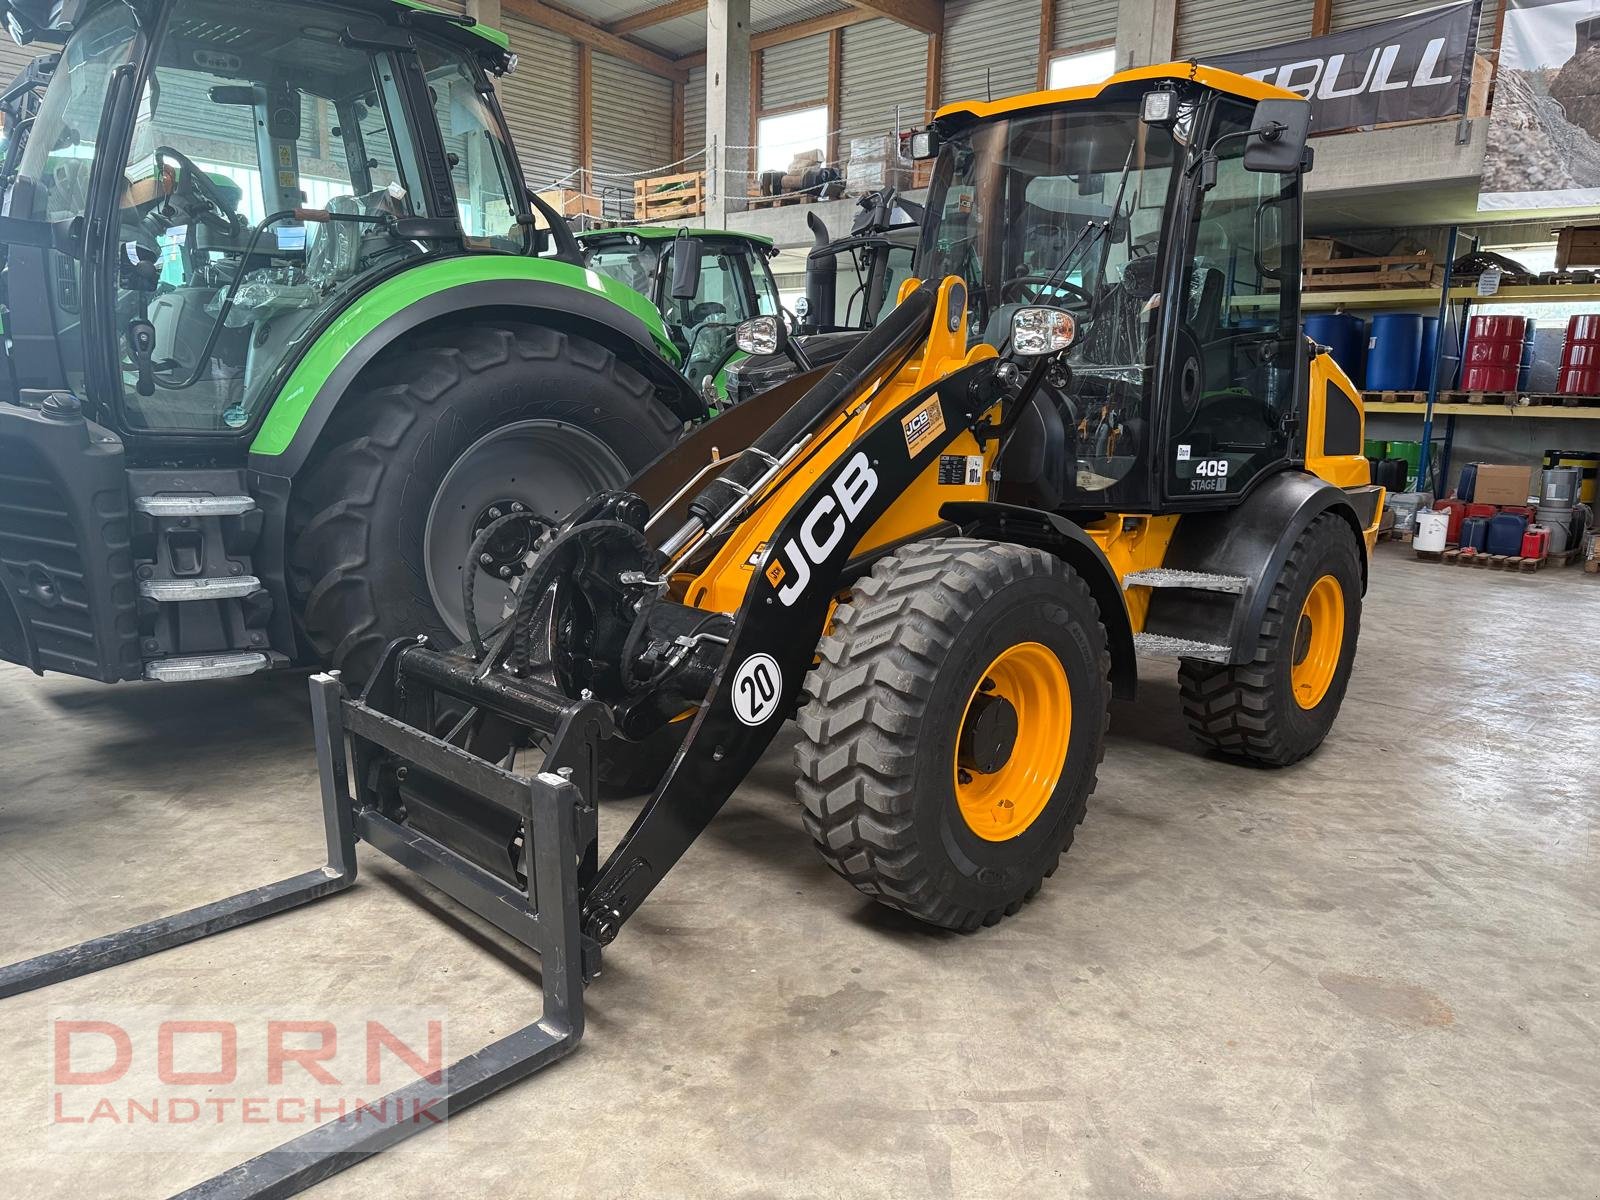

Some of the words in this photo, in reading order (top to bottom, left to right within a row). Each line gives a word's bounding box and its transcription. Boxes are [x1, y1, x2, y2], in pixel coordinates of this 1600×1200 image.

[906, 410, 929, 436] JCB
[1196, 460, 1228, 477] 409
[1190, 479, 1216, 491] STAGE
[778, 452, 879, 607] JCB
[741, 663, 776, 718] 20
